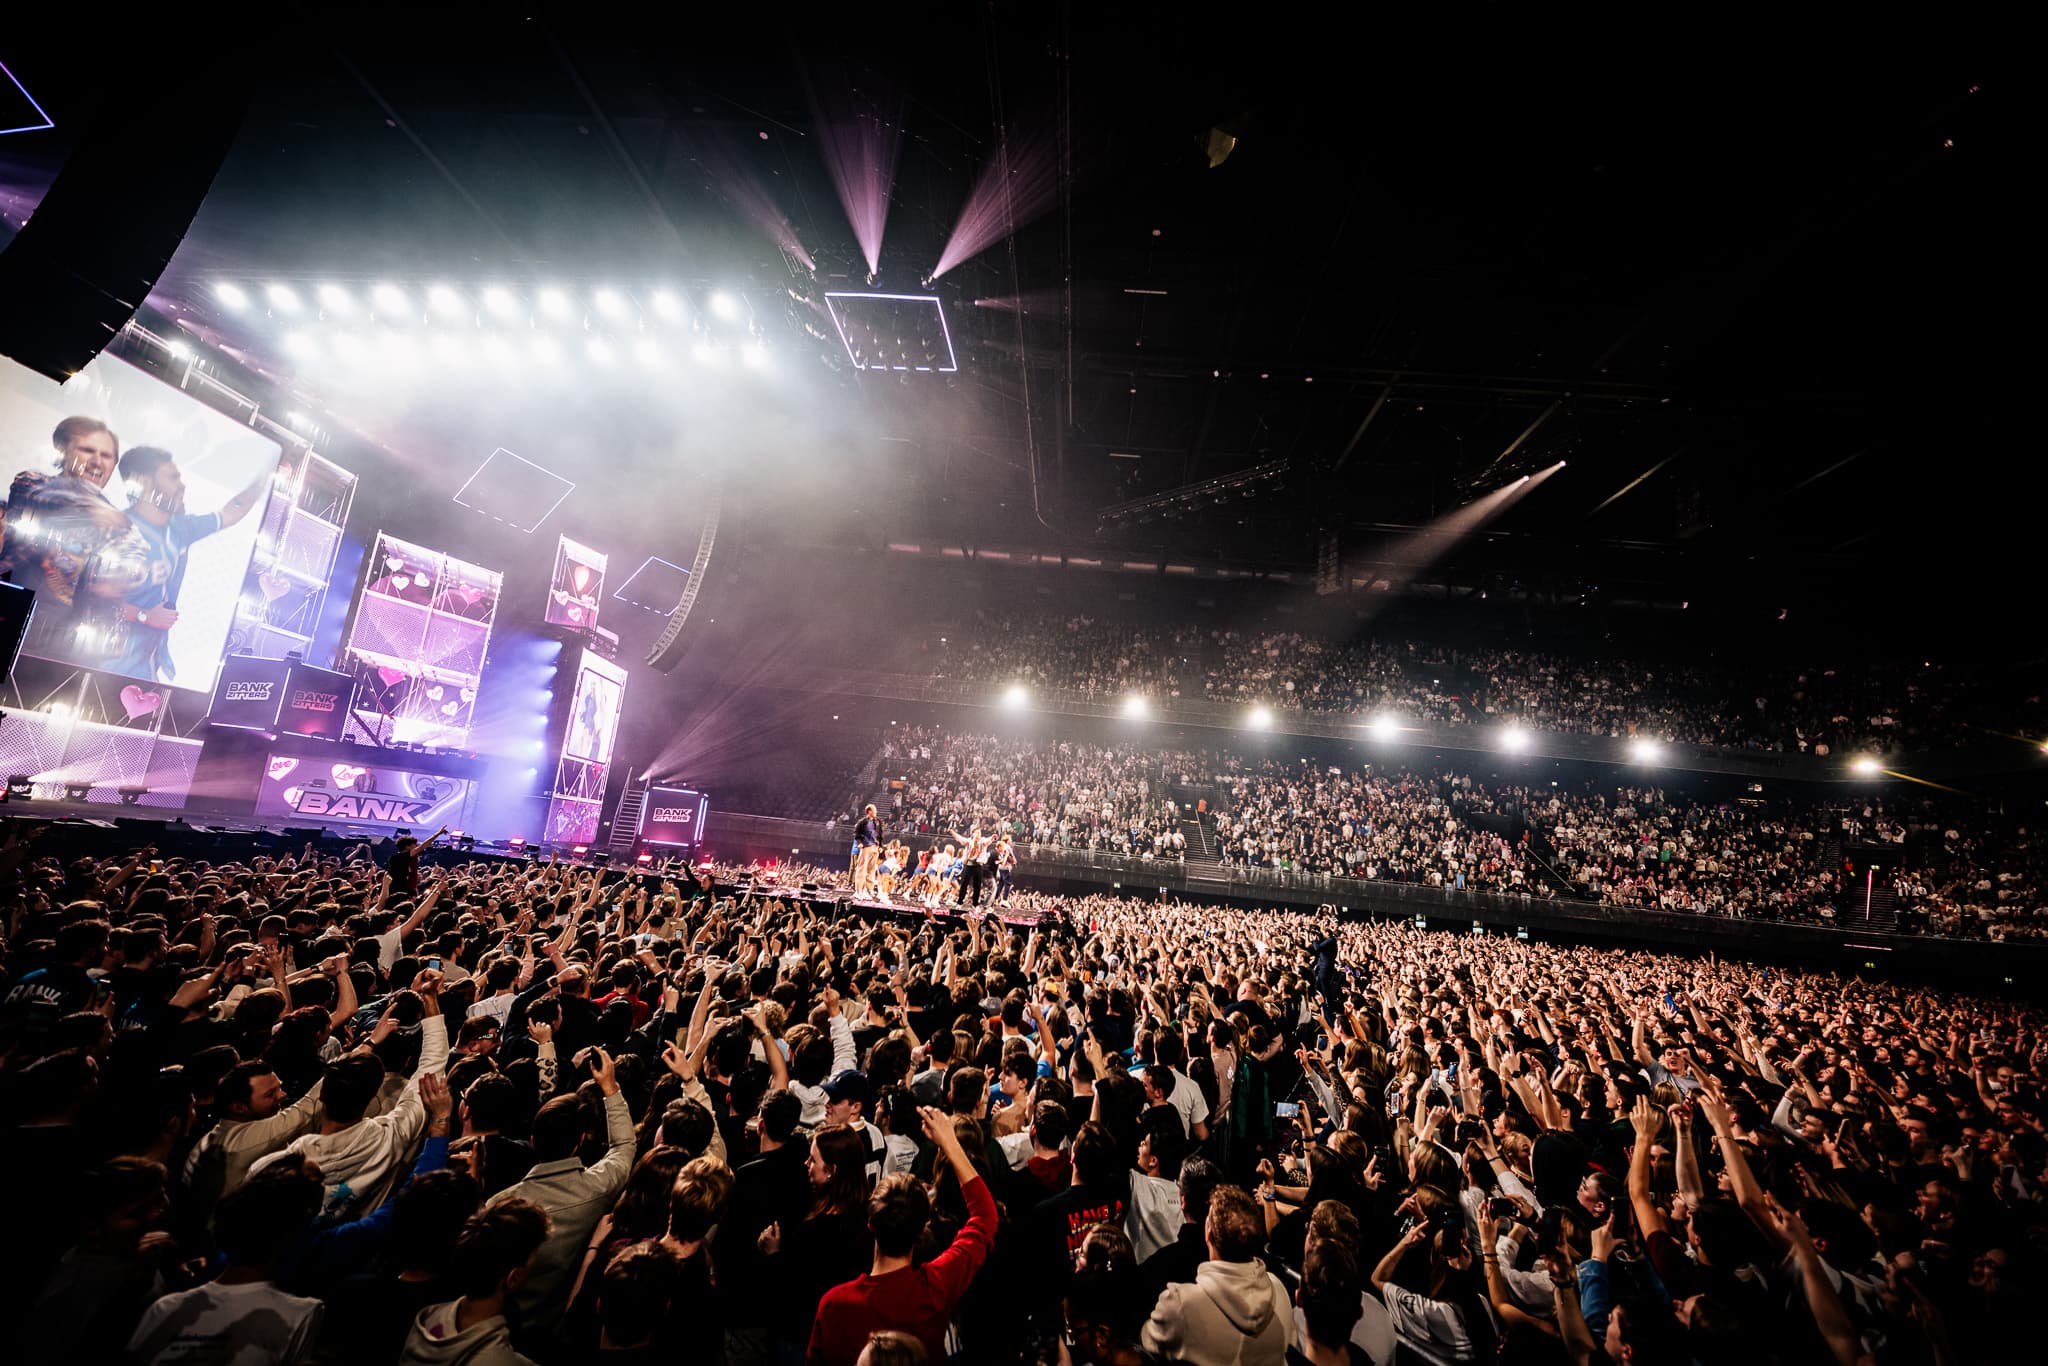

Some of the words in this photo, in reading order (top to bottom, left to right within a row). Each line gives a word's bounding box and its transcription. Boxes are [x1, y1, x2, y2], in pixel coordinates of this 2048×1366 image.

[228, 682, 272, 692] BANK
[226, 691, 270, 699] ZITTERS
[294, 691, 336, 703] BANK
[292, 700, 333, 710] ZITTERS
[298, 791, 425, 823] BANK
[655, 808, 690, 816] BANK
[1068, 1204, 1109, 1233] HAVE
